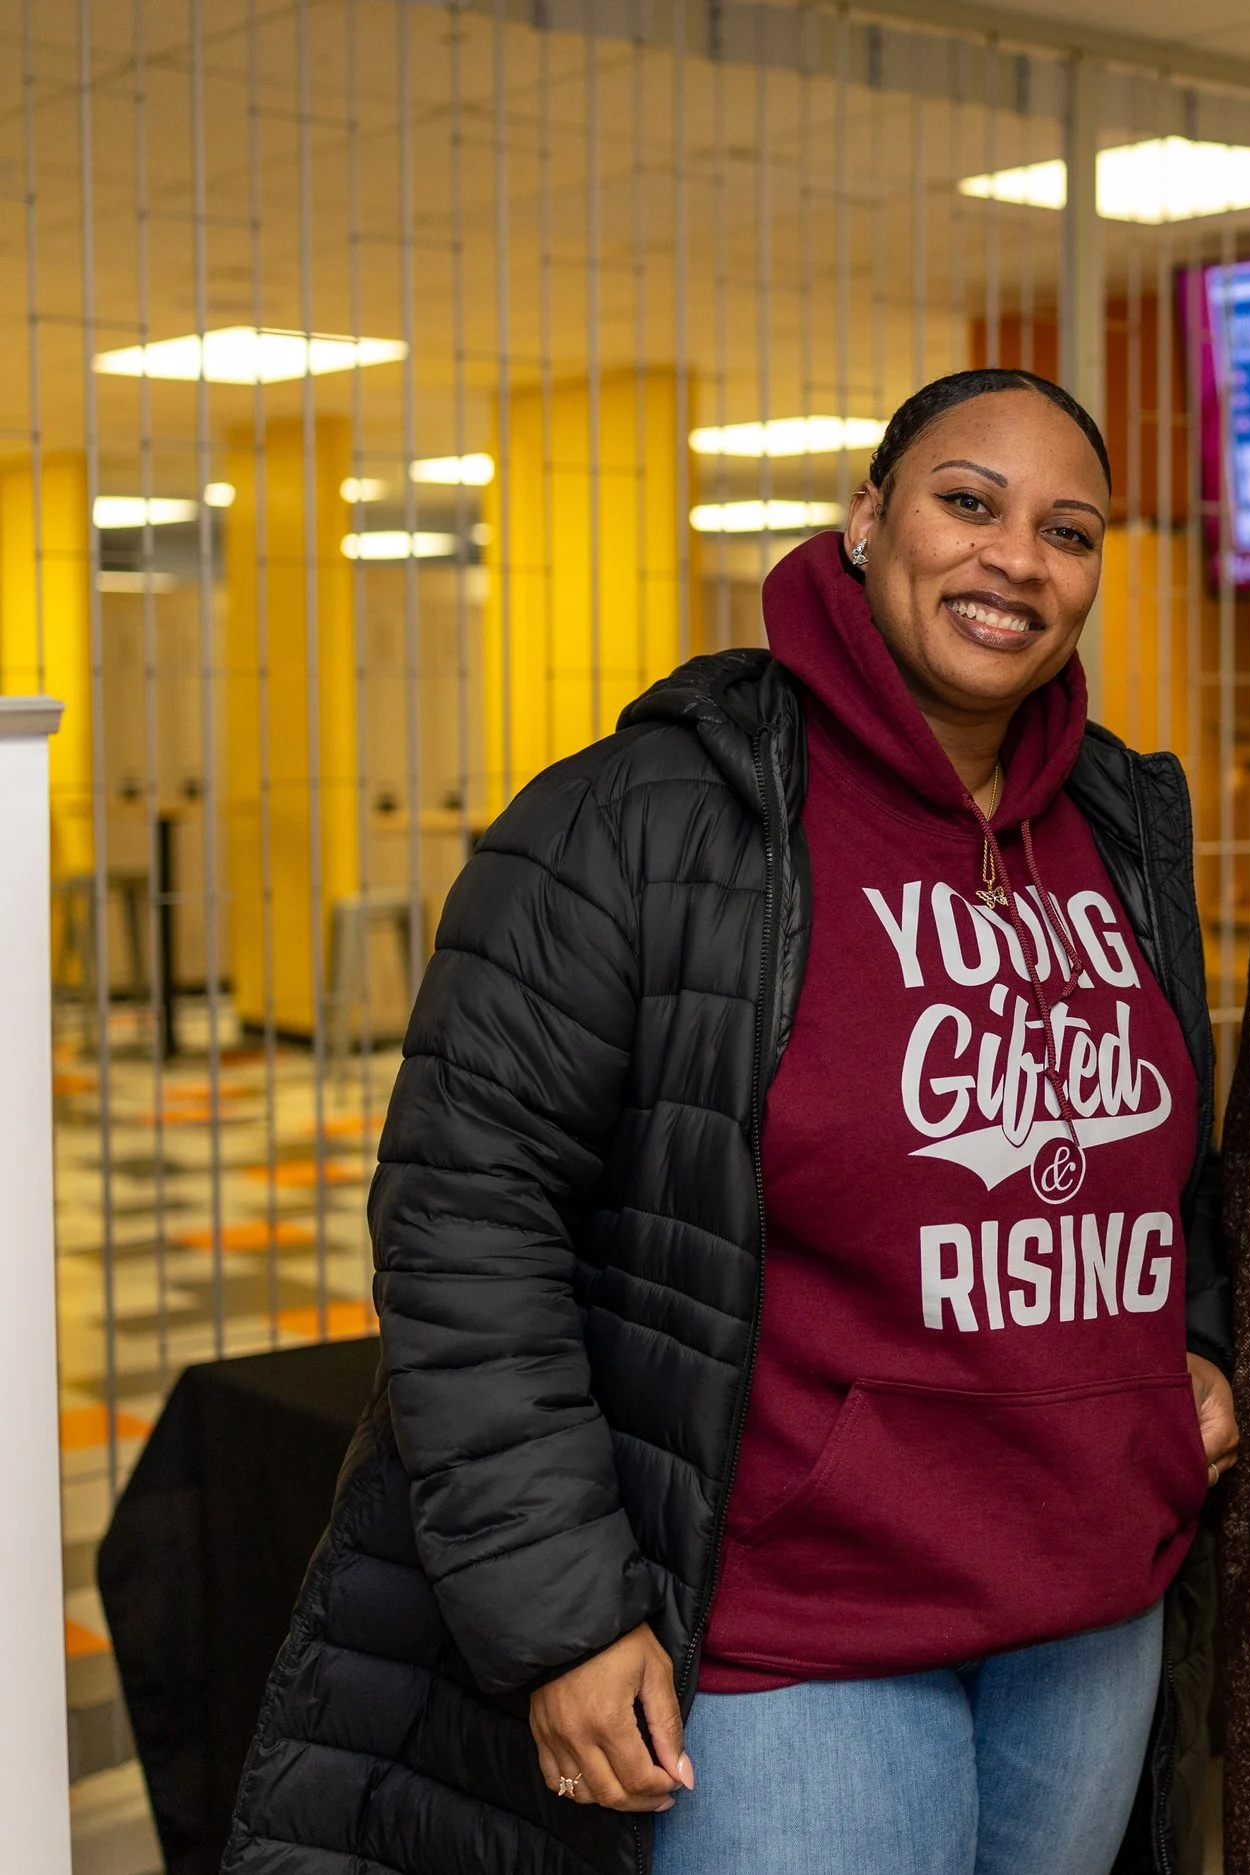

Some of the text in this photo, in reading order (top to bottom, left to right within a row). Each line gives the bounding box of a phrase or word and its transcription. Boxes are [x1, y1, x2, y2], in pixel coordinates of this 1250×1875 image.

[901, 983, 1142, 1138] Gifted
[1040, 1145, 1077, 1193] &
[920, 1210, 1174, 1333] RISING
